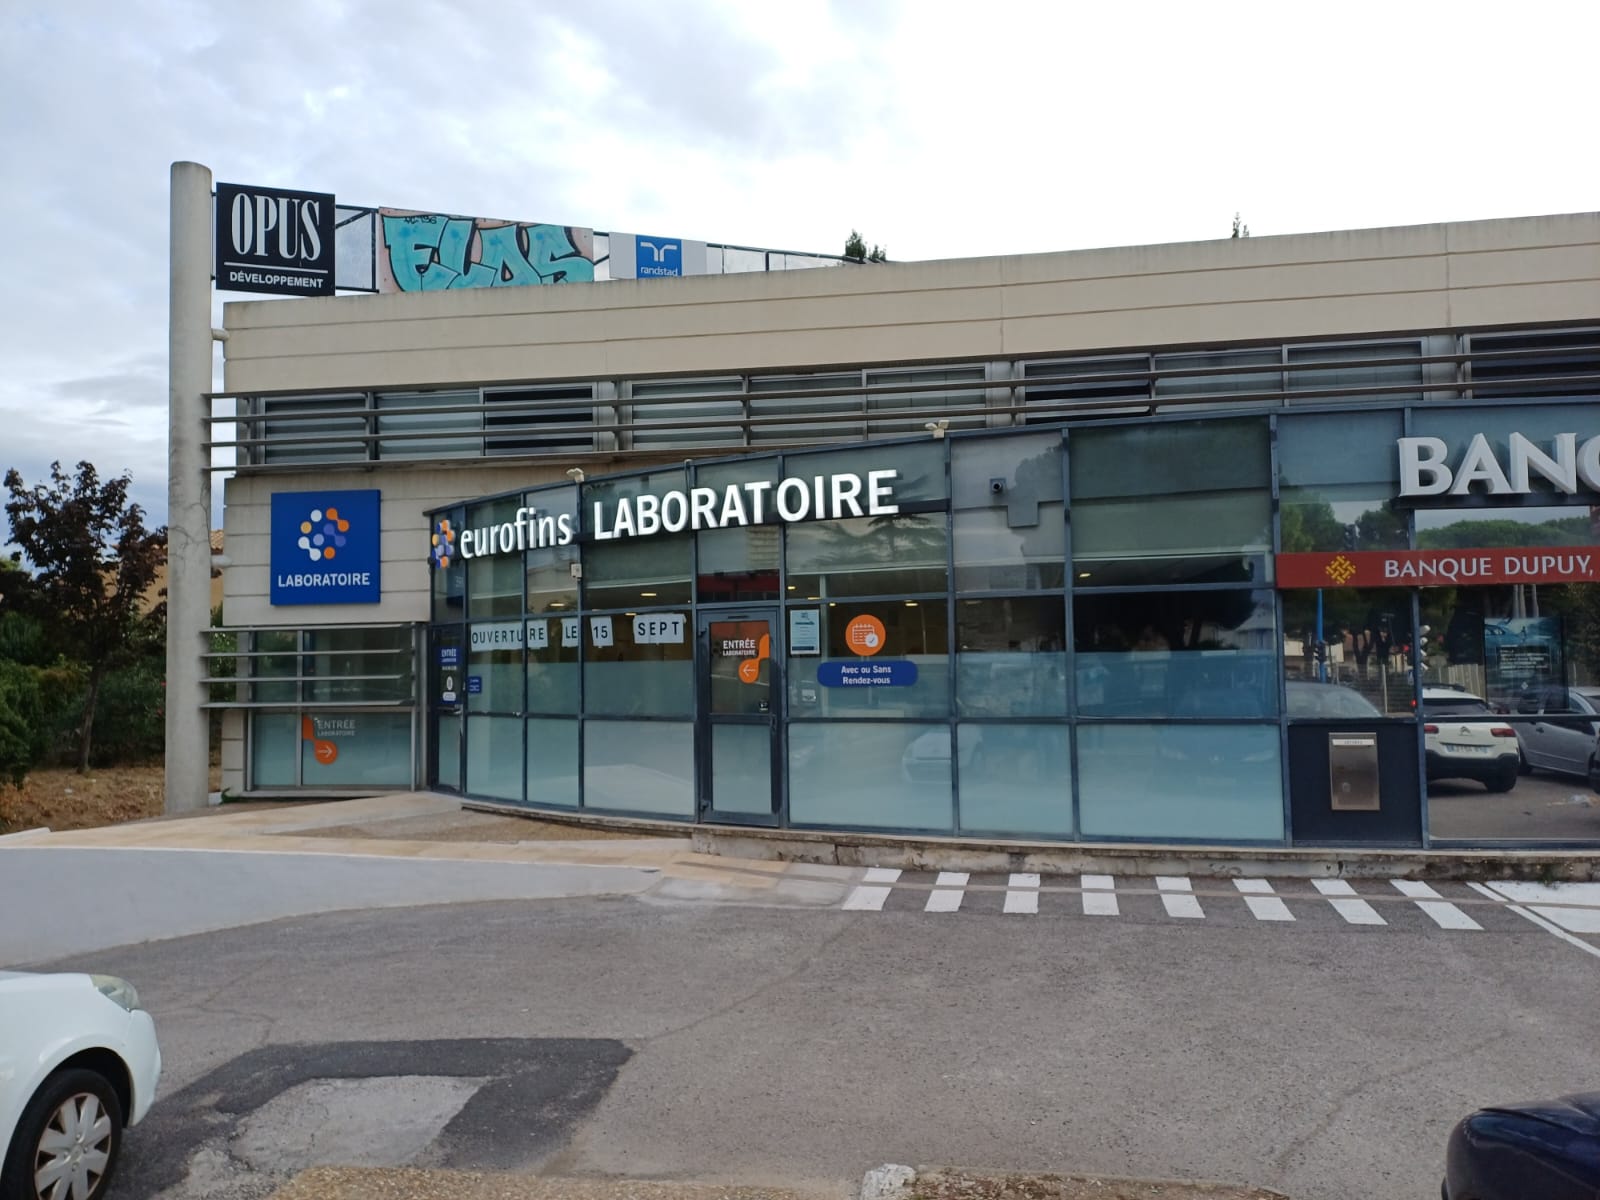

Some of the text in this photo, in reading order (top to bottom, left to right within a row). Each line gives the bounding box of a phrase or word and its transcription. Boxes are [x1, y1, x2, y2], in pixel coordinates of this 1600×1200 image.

[231, 192, 321, 261] OPUS
[229, 270, 324, 289] DÉVELOPPEMENT
[640, 266, 679, 277] randstad
[460, 469, 900, 560] eurofins LABORATOIRE
[1384, 555, 1594, 582] BANQUE DUPUY,
[278, 572, 371, 588] LABORATOIRE
[471, 621, 680, 645] OUVERTURE LE 15 SEPT
[723, 637, 756, 649] ENTRÉE
[841, 665, 860, 674] Avec
[872, 665, 892, 674] Sans
[842, 676, 891, 685] Rendez-vous
